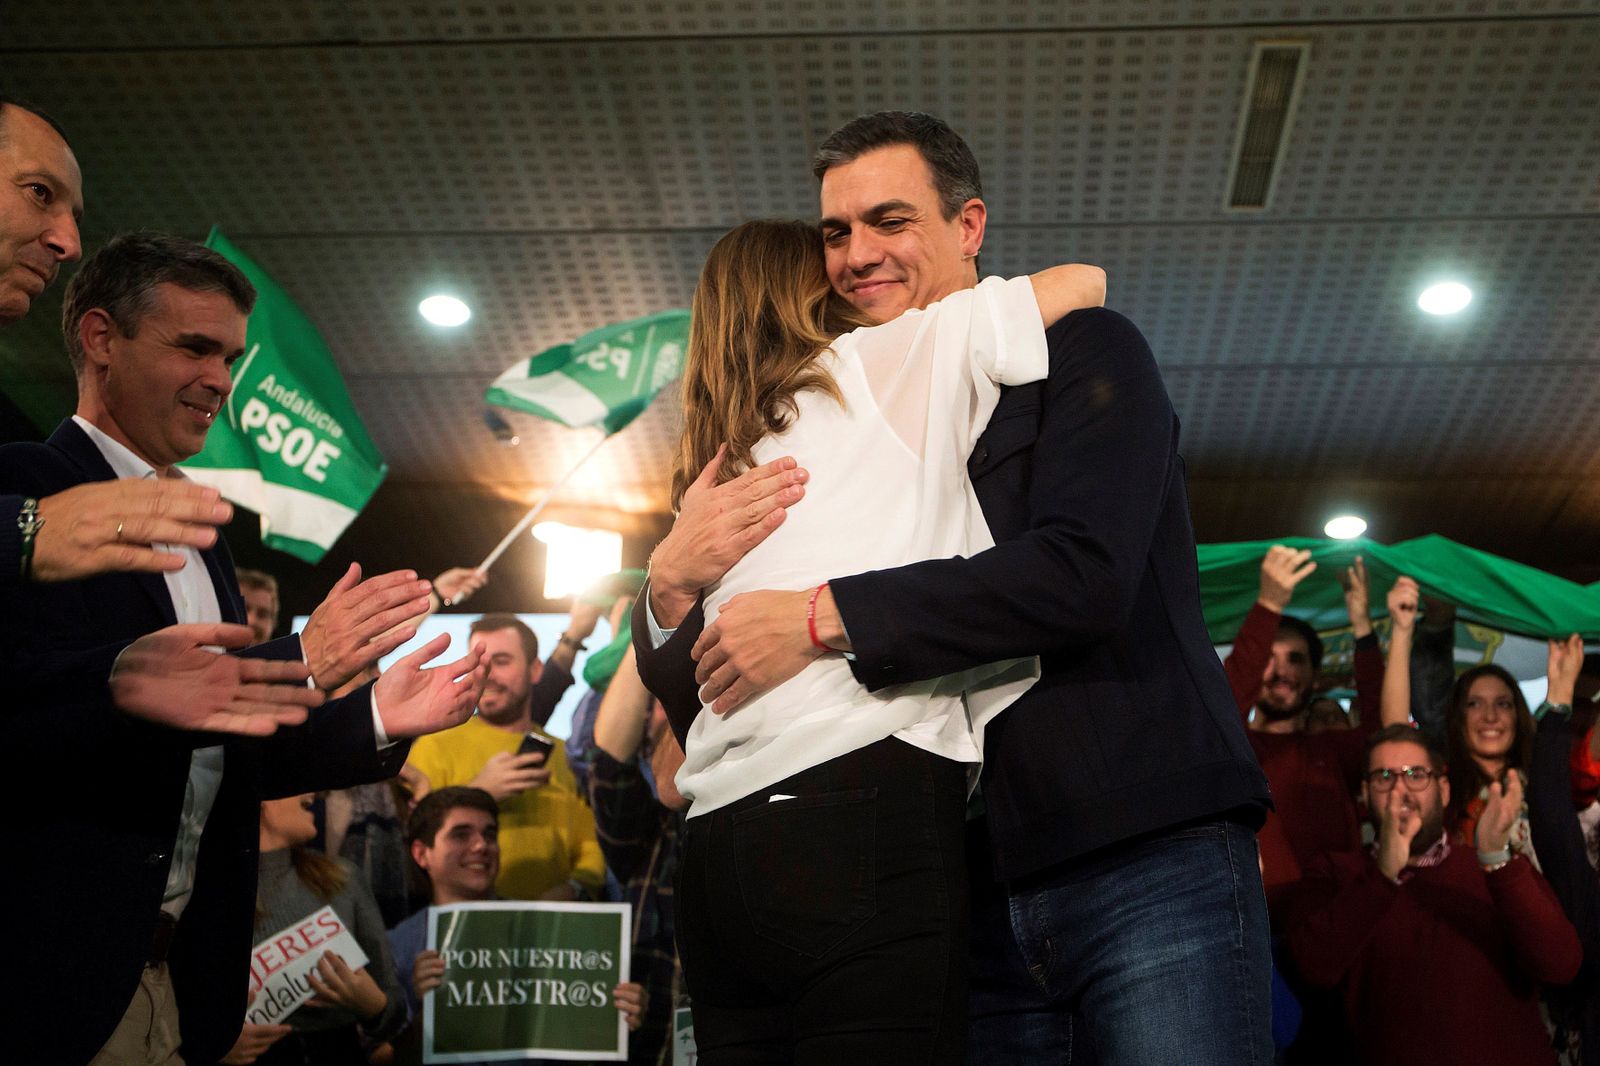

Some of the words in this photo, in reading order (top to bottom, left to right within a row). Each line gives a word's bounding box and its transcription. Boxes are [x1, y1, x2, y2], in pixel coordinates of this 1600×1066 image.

[241, 397, 341, 483] PSOE
[444, 948, 492, 969] POR
[497, 948, 613, 970] NUESTR@S
[246, 966, 318, 1025] ndalu
[447, 978, 609, 1007] MAESTR@S
